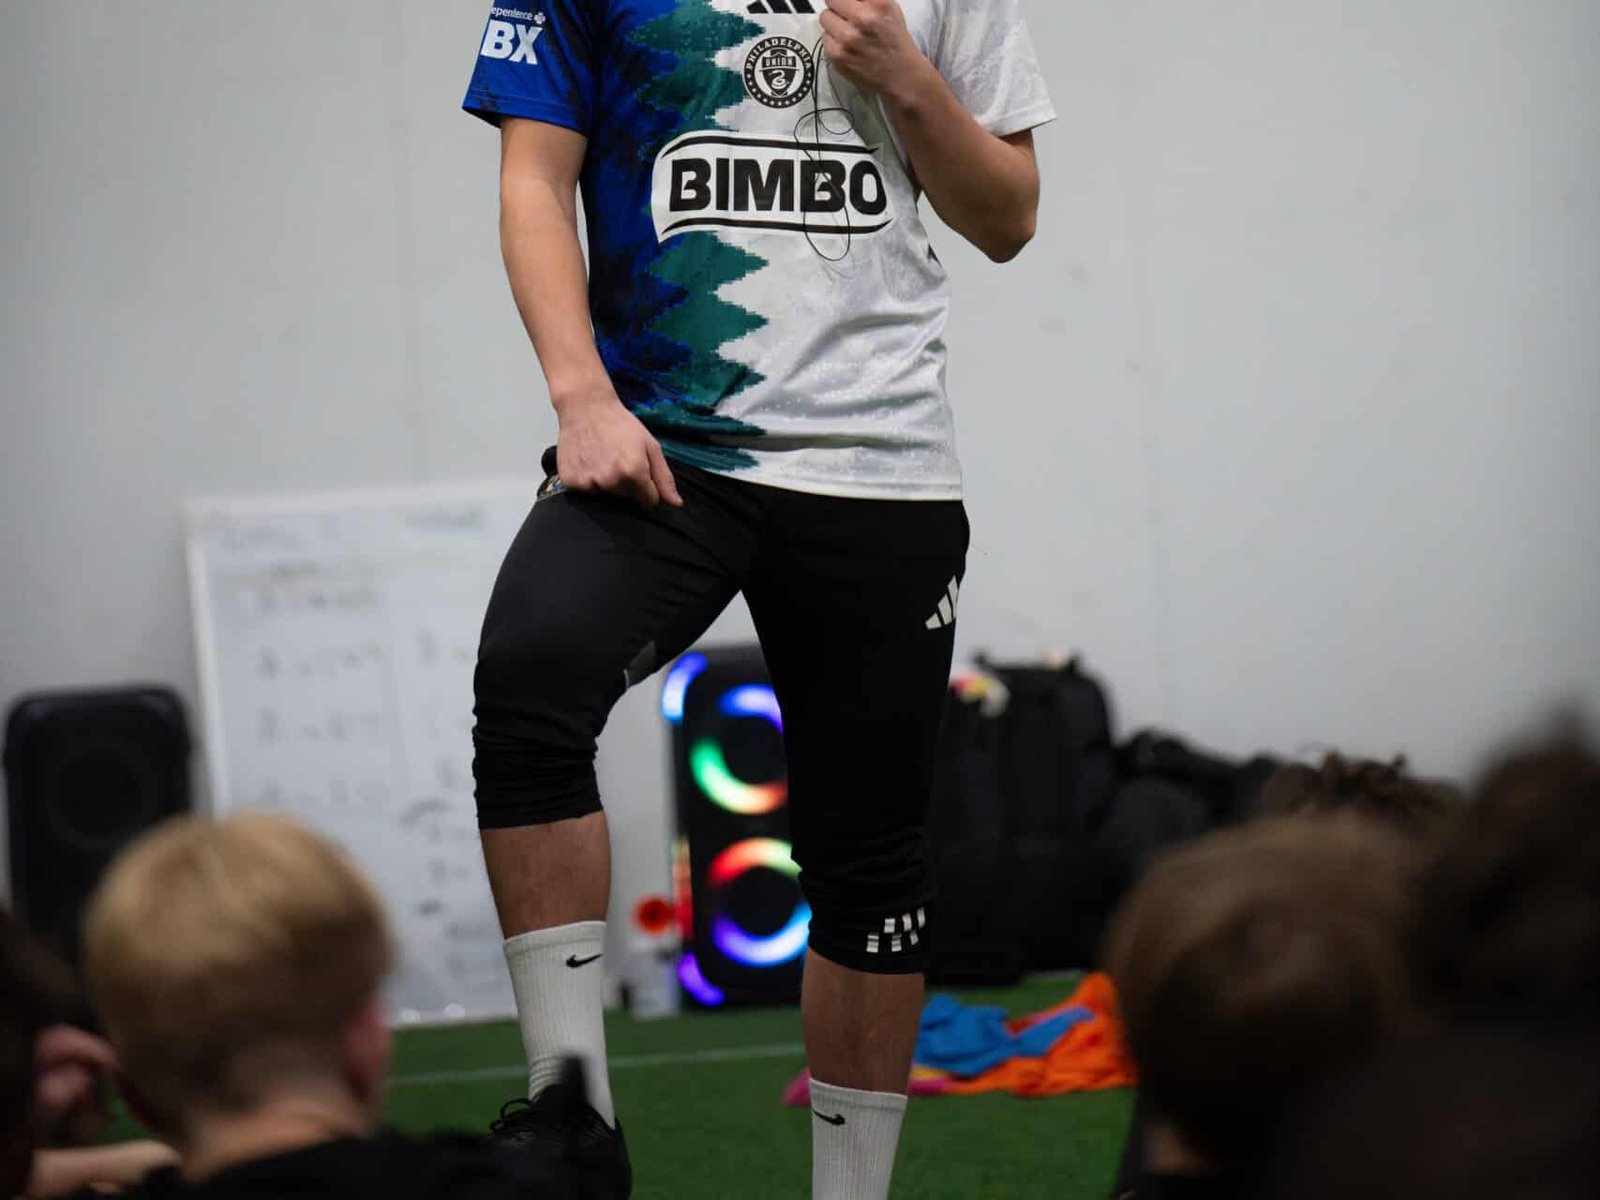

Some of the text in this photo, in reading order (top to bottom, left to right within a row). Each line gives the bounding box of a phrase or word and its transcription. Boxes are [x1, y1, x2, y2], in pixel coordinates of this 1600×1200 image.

[746, 38, 813, 70] PHILADELPHIA
[765, 57, 794, 67] UNION
[669, 157, 888, 216] BIMBO
